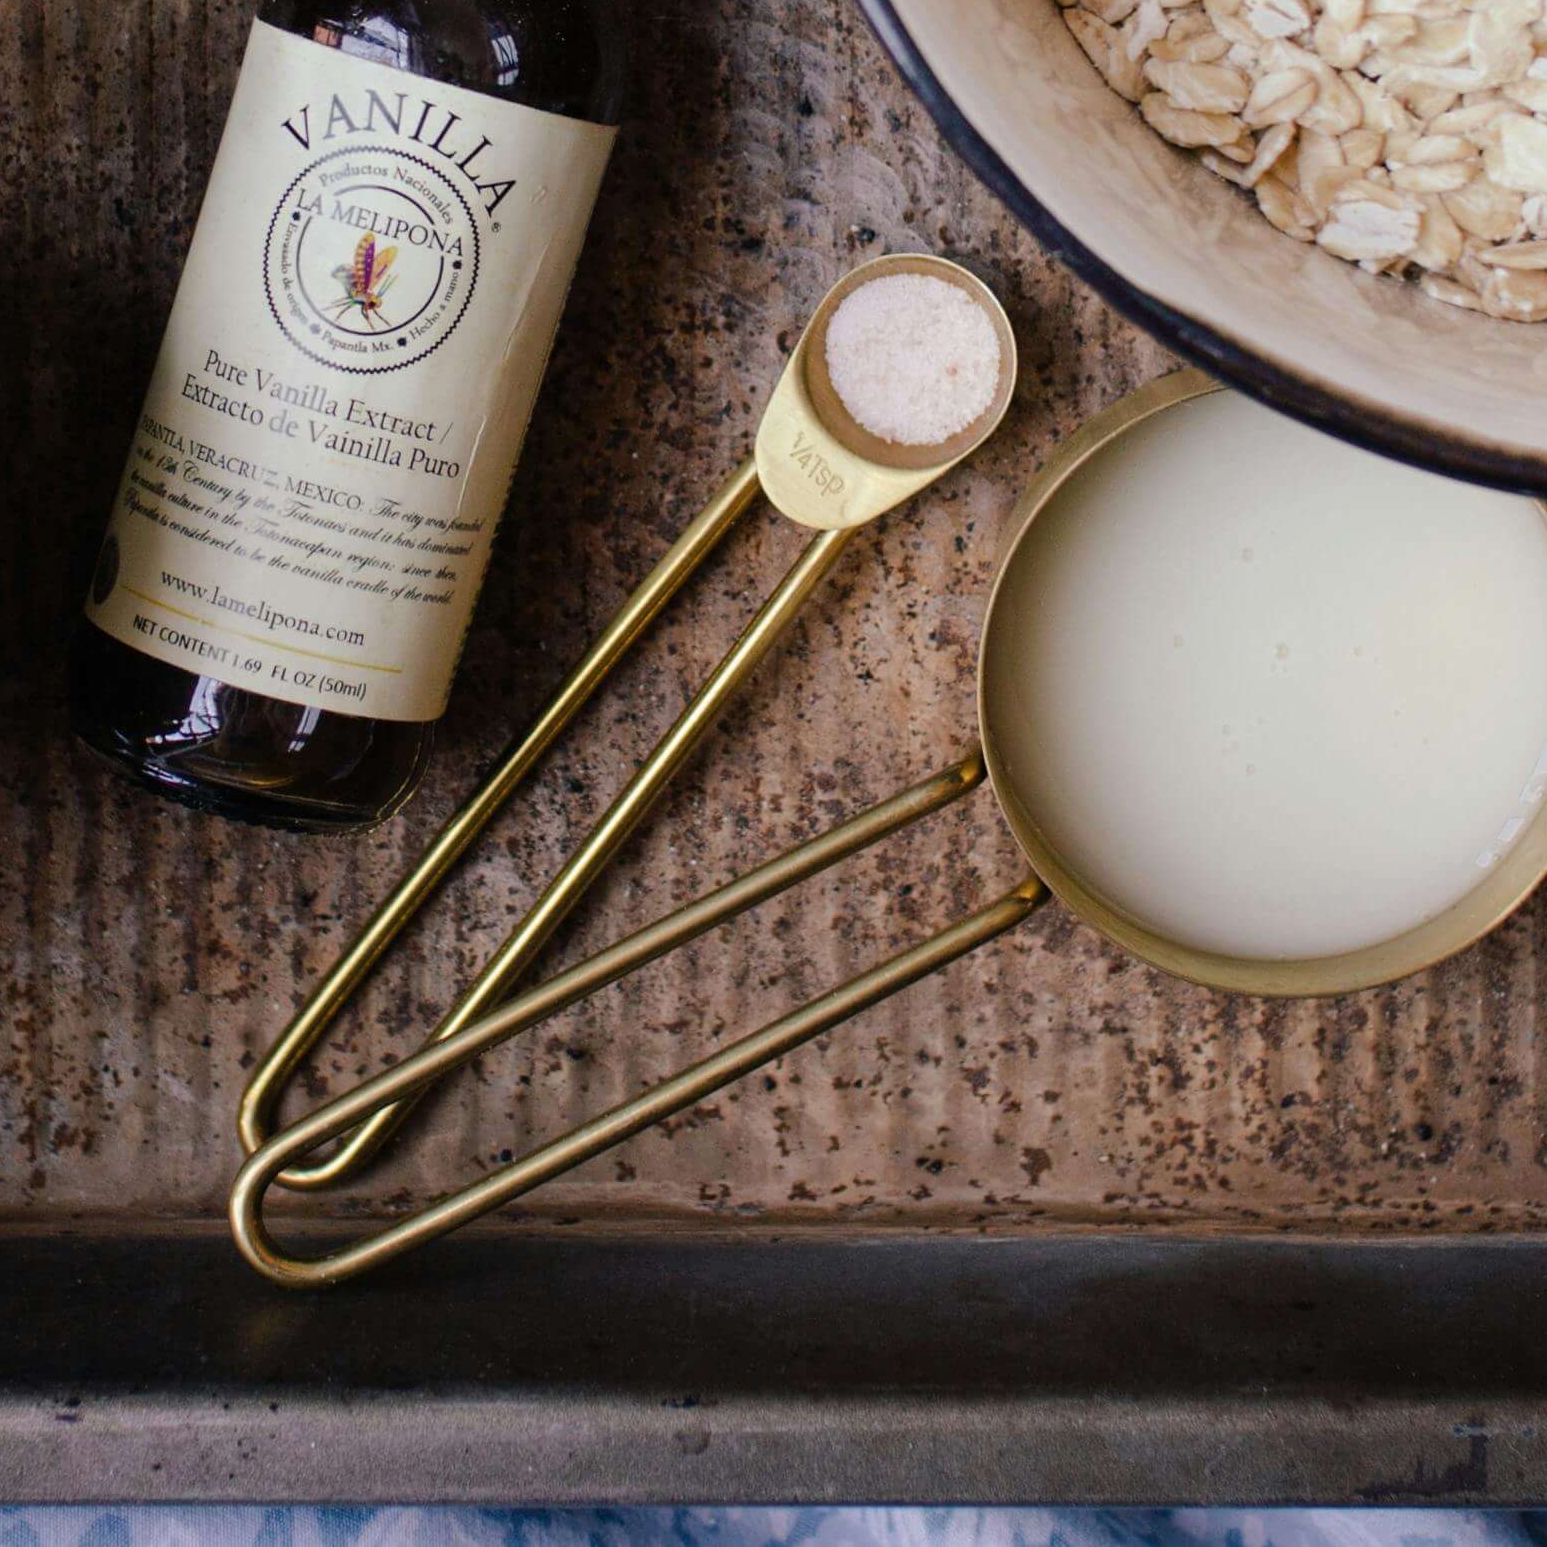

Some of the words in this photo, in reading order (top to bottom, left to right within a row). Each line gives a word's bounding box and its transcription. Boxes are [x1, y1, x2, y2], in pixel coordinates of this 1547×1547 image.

[281, 89, 516, 217] VANILLA
[296, 188, 324, 216] LA
[331, 200, 464, 257] MELIPONA
[319, 163, 388, 187] Productos
[394, 166, 453, 225] Nacionales
[283, 278, 294, 291] de
[409, 311, 440, 340] Hecho
[444, 272, 459, 303] mano
[321, 331, 368, 353] Papantla
[180, 373, 264, 426] Extracto
[269, 409, 300, 439] de
[308, 419, 403, 468] Vainilla
[407, 447, 461, 479] Puro
[204, 349, 247, 387] Pure
[254, 368, 338, 417] Vanilla
[344, 398, 438, 442] Extract
[183, 460, 234, 502] Century
[348, 524, 383, 543] and
[392, 534, 415, 550] has
[221, 511, 243, 528] the
[168, 520, 236, 552] considered
[268, 554, 292, 570] the
[292, 563, 344, 586] vanilla
[160, 570, 366, 646] www.lamelipona.com
[132, 614, 157, 636] NET
[159, 626, 230, 665] CONTENT
[232, 650, 262, 674] 1.69
[270, 664, 290, 683] FL
[292, 668, 317, 689] OZ
[317, 674, 367, 702] (50ml)
